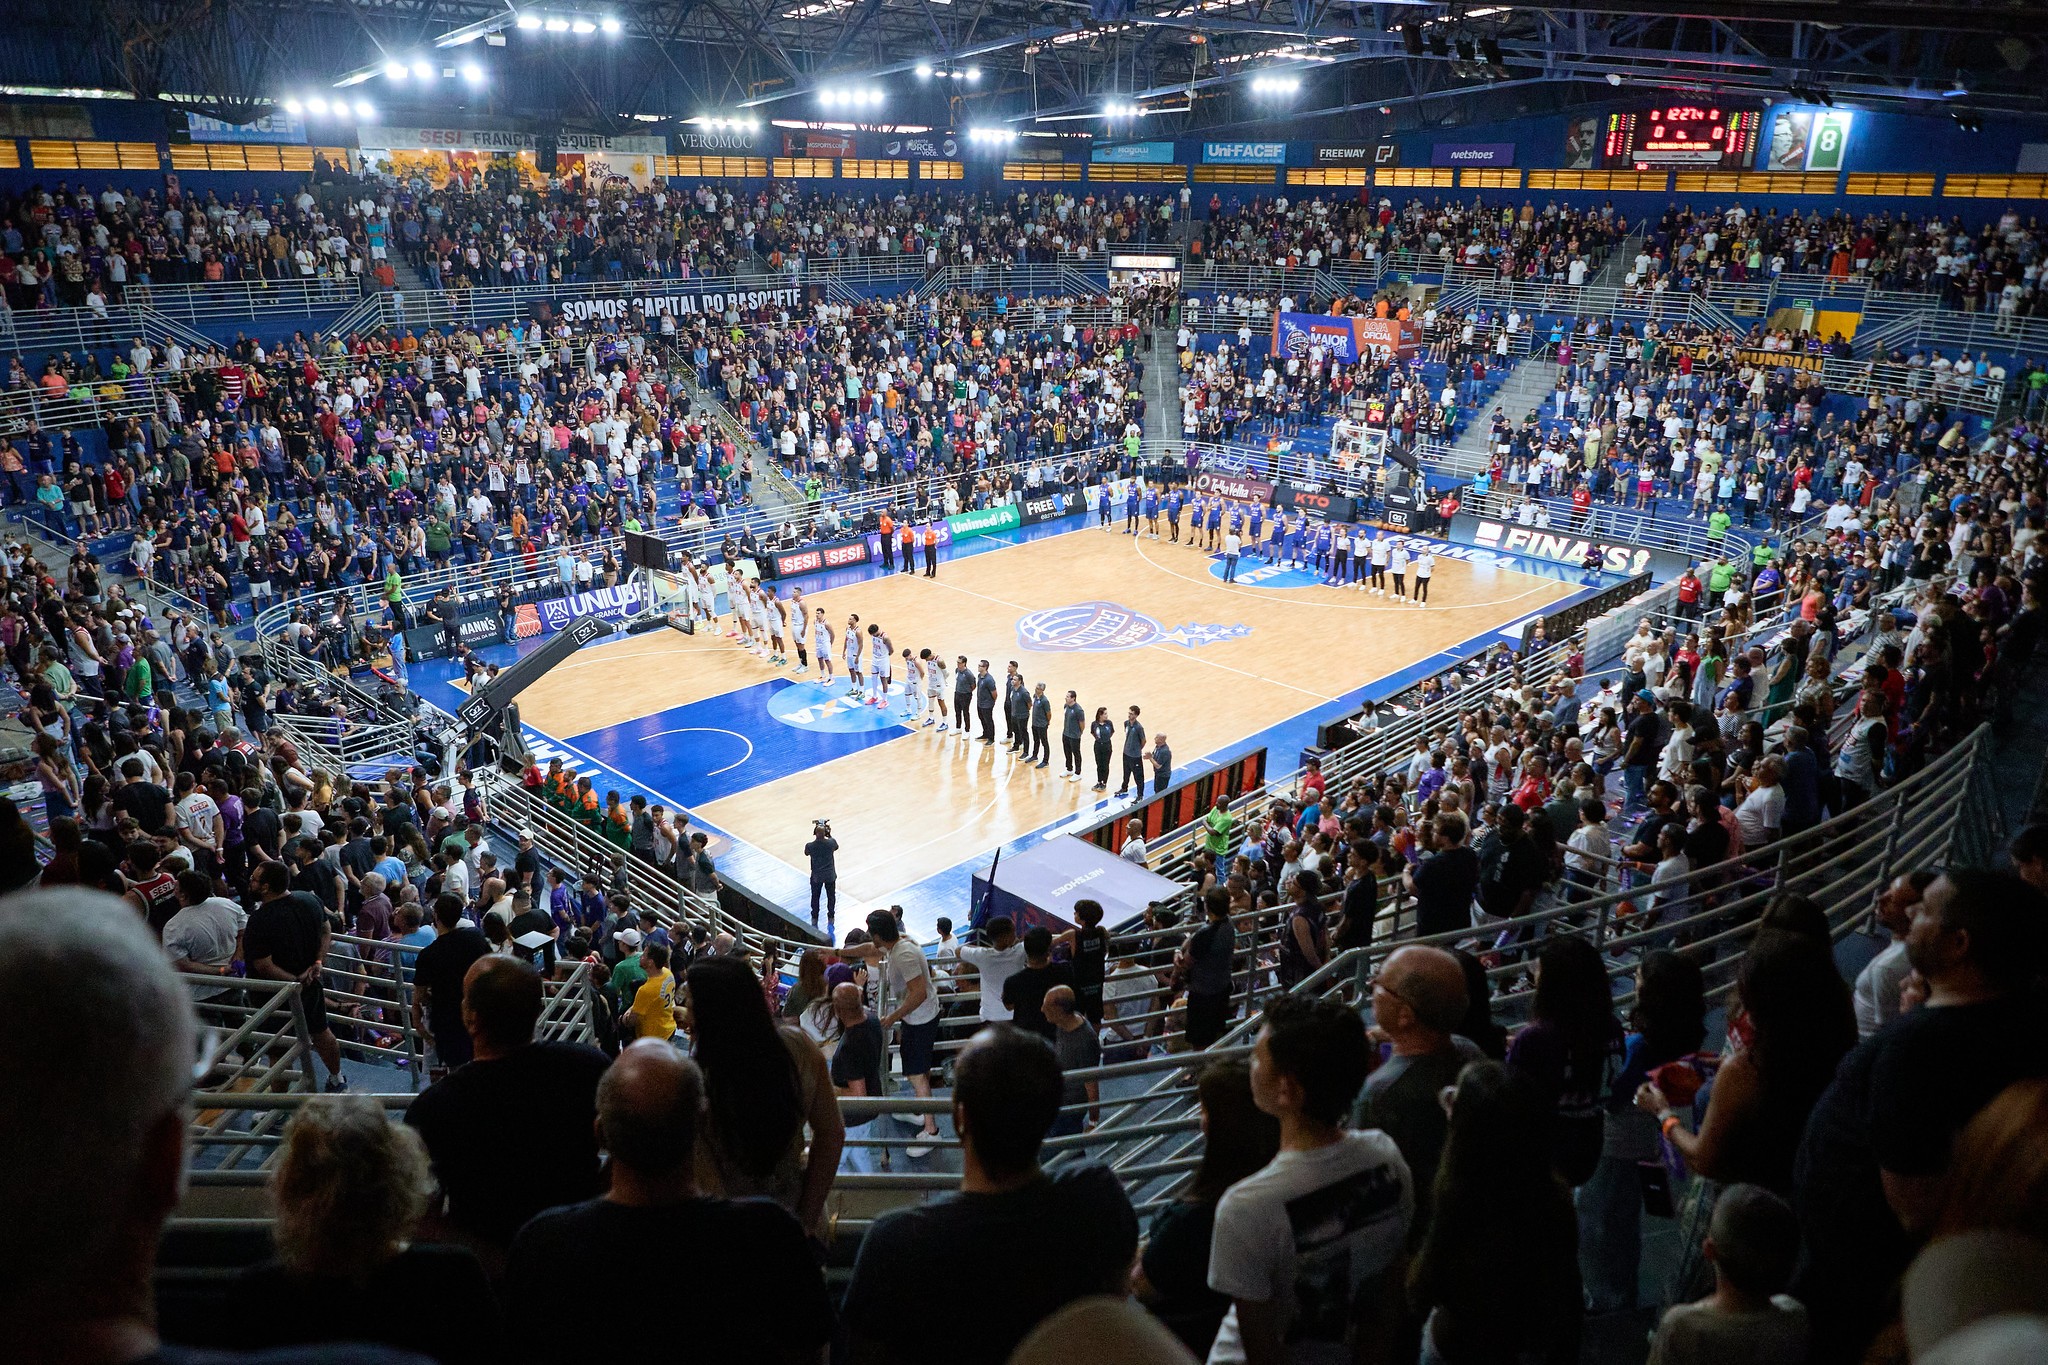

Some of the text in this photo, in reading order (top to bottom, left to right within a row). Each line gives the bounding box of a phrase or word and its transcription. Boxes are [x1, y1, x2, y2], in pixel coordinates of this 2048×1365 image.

[420, 130, 461, 144] SESI
[679, 134, 753, 151] VEROMOC
[1820, 130, 1837, 151] 8
[1208, 144, 1282, 157] Uni-FACEF
[1320, 149, 1366, 158] FREEWAY
[1451, 150, 1494, 159] netshoes
[562, 299, 627, 322] SOMOS
[633, 295, 699, 317] CAPITAL
[702, 294, 724, 314] DO
[1365, 321, 1389, 332] LOJA
[1310, 333, 1348, 347] MAIOR
[1363, 331, 1392, 342] OFICIAL
[1294, 492, 1330, 508] KTO
[952, 513, 998, 534] Unimed
[828, 546, 861, 564] SESI
[783, 554, 818, 572] SESI
[153, 882, 171, 897] SESI
[1051, 867, 1105, 897] NETSHOES
